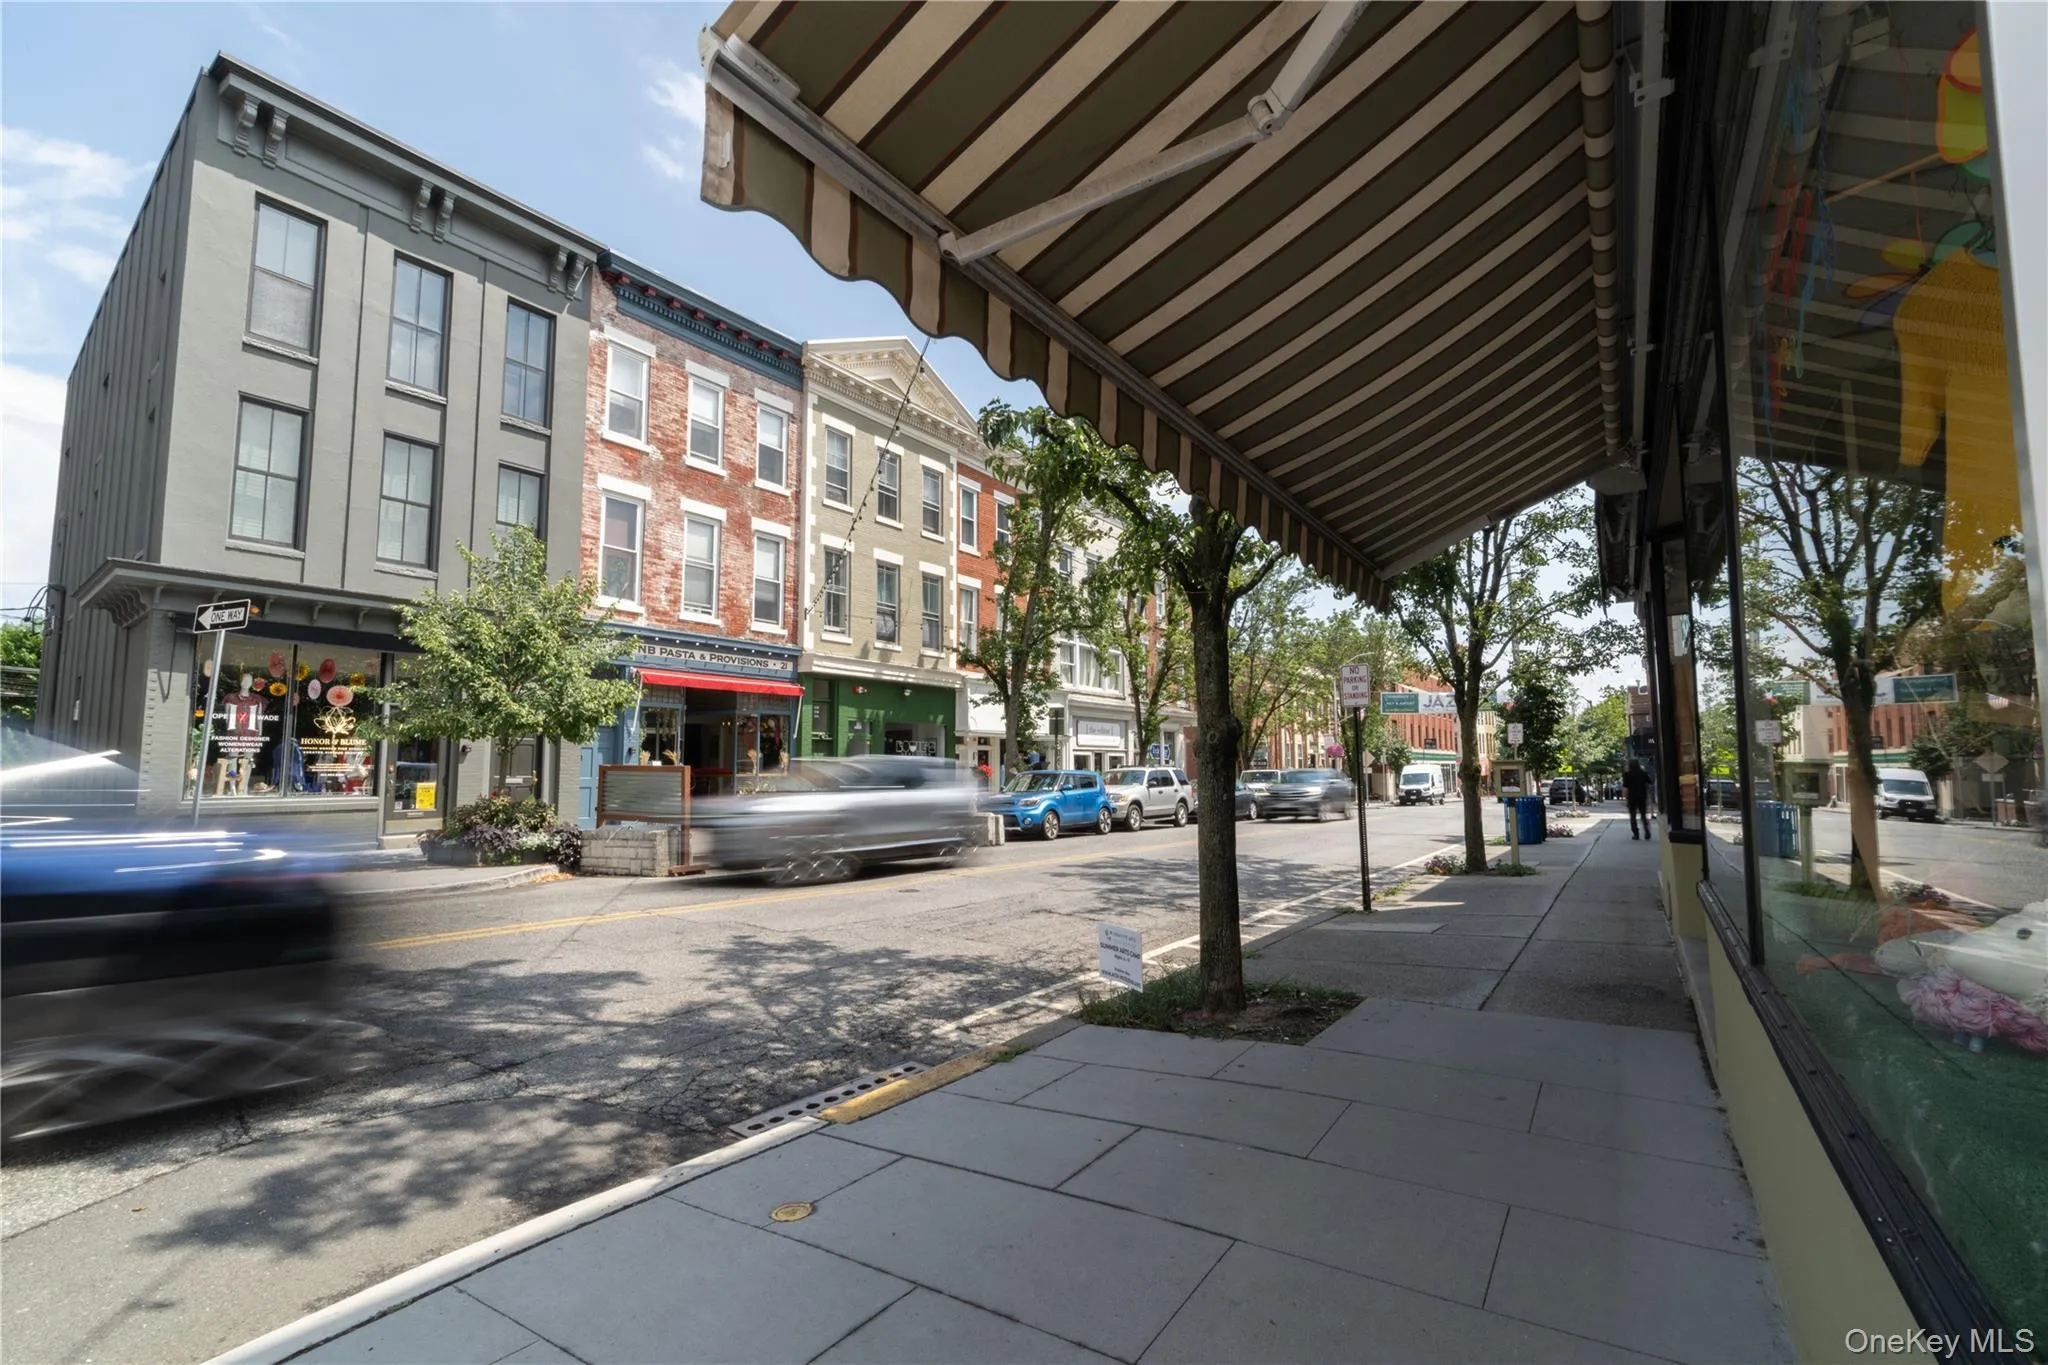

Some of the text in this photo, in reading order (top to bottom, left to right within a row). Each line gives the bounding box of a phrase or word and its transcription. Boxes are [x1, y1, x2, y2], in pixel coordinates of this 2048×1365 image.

[211, 608, 243, 622] ONE WAY
[638, 645, 656, 655] NB
[660, 647, 695, 659] PASTA
[709, 653, 769, 668] PROVISIONS
[780, 662, 787, 670] 21
[1349, 664, 1360, 674] NO
[1343, 676, 1367, 684] PARKING
[1343, 692, 1368, 700] STANDING
[1423, 694, 1457, 708] JAZ
[340, 738, 367, 746] BLUME
[1100, 941, 1120, 952] SUMMER
[1119, 947, 1130, 956] ARTS
